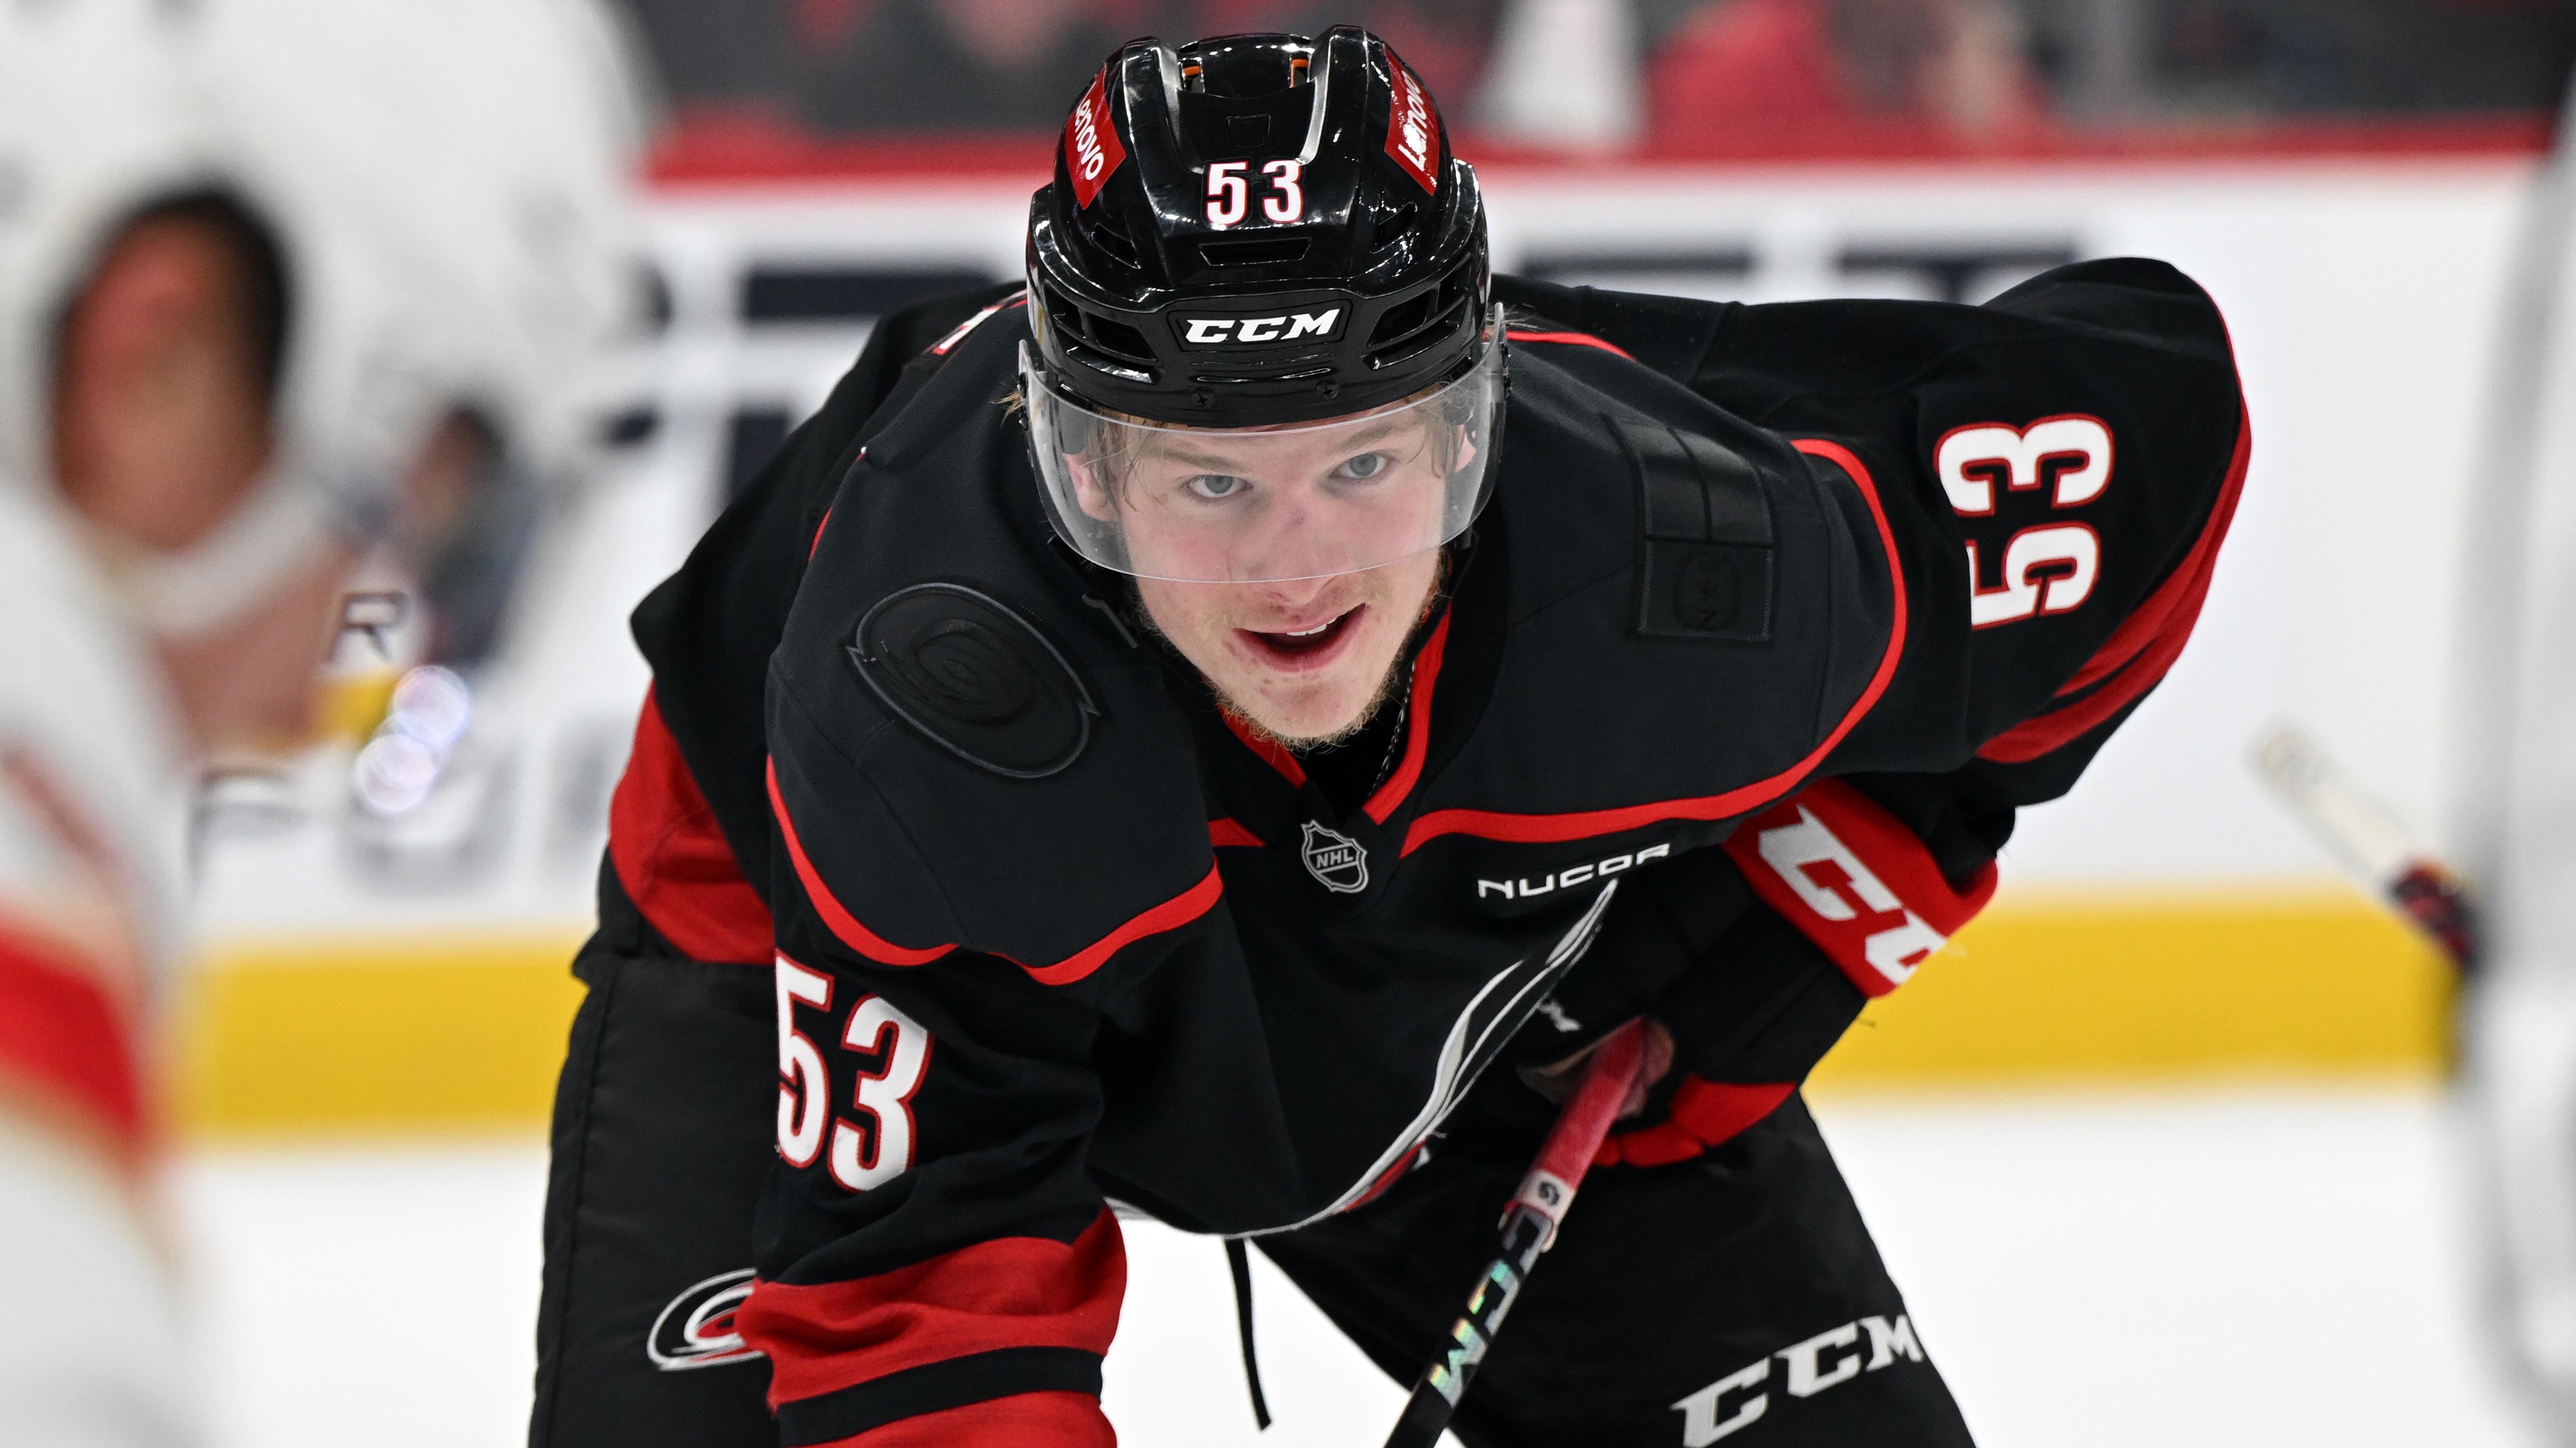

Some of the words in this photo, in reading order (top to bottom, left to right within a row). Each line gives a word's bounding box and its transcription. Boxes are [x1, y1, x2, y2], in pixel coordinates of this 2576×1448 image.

[1207, 160, 1305, 227] 53
[1186, 308, 1340, 343] CCM
[1932, 412, 2116, 632] 53
[1315, 848, 1355, 869] NHL
[1477, 843, 1671, 899] NUCOR
[774, 947, 936, 1194] 53
[1428, 1205, 1554, 1409] CCM
[1668, 1314, 1925, 1448] CCM
